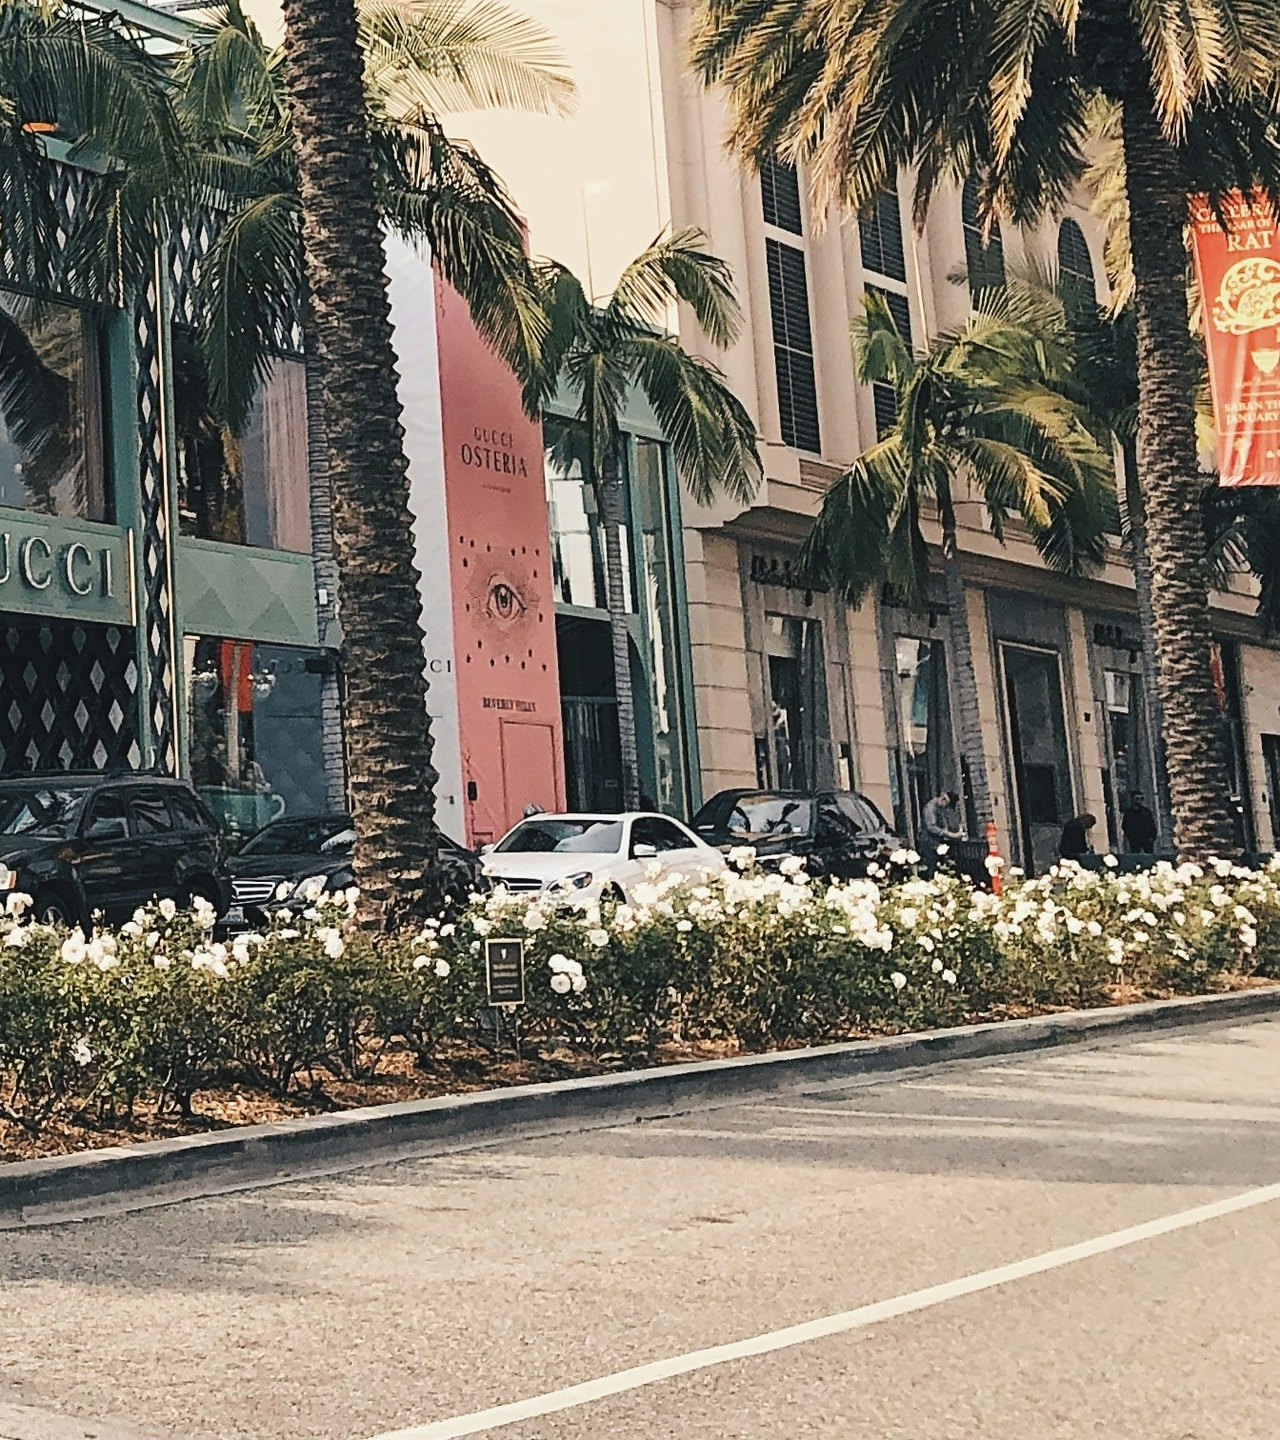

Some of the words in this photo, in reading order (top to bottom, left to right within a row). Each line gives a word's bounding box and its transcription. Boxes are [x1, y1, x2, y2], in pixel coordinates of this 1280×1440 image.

[1227, 231, 1274, 252] RAT
[474, 426, 513, 448] GUCCI
[461, 443, 528, 478] OSTERIA
